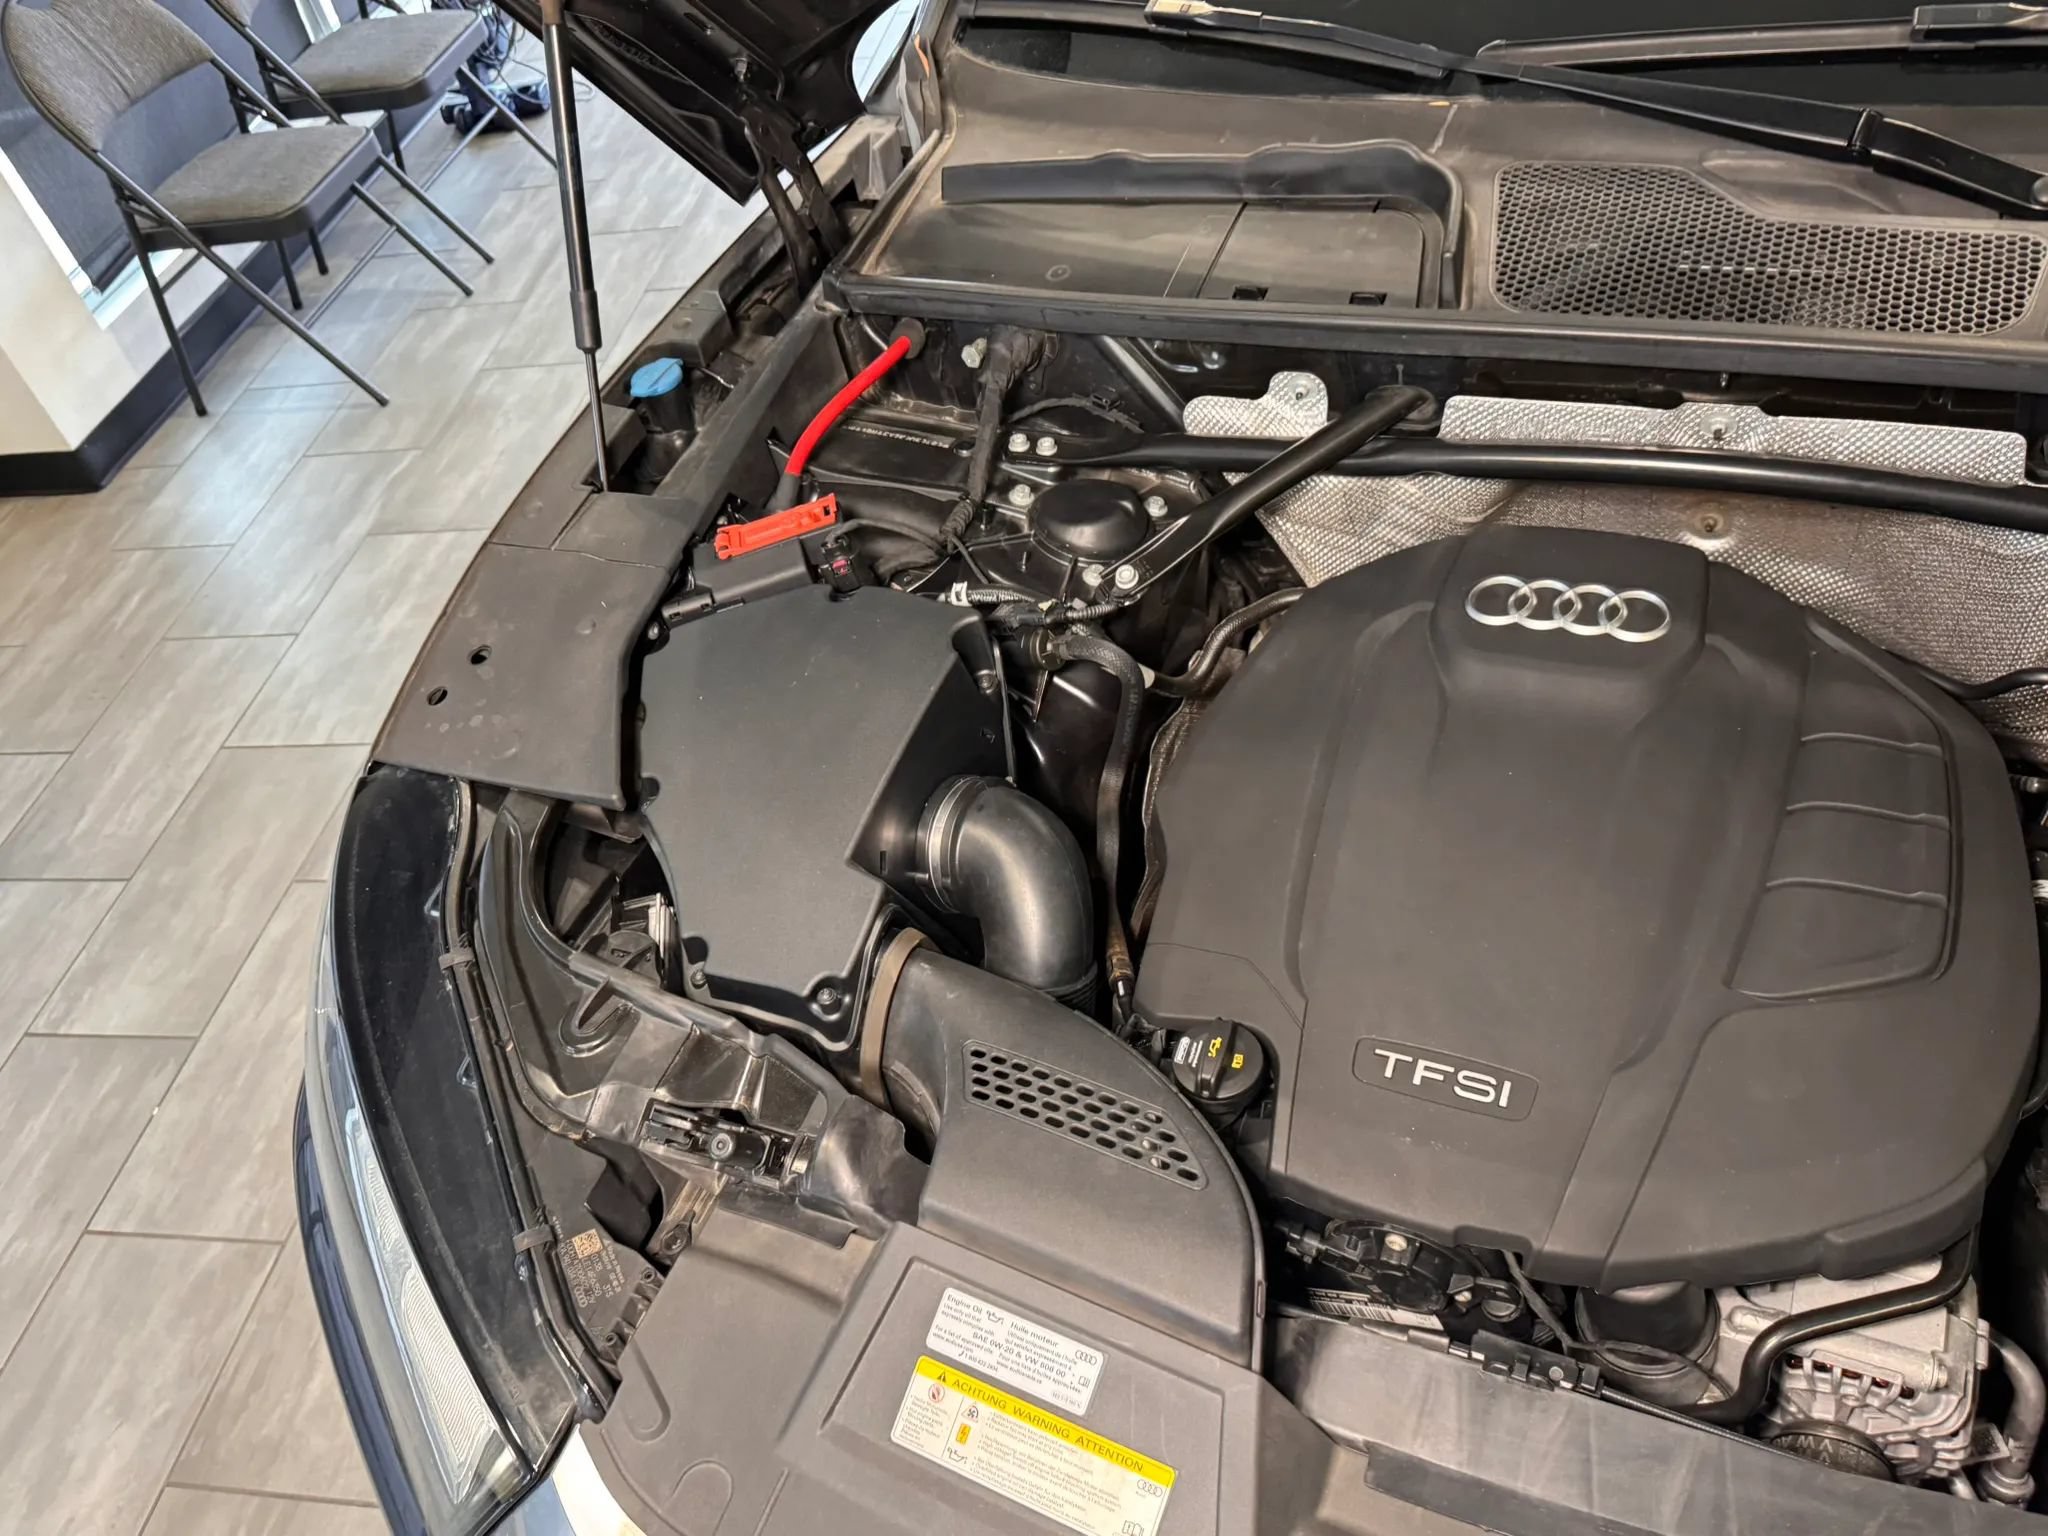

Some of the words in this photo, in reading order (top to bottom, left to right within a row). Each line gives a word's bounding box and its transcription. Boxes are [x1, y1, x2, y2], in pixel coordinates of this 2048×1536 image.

[1374, 1048, 1512, 1108] TFSI
[947, 1294, 970, 1309] Engine
[972, 1305, 982, 1314] Oil
[973, 1332, 988, 1343] SAE
[1025, 1355, 1038, 1365] VW
[1010, 1322, 1028, 1334] Huile
[1030, 1332, 1058, 1347] moteur
[952, 1379, 1006, 1410] ACHTUNG
[1013, 1406, 1069, 1439] WARNING
[1076, 1436, 1144, 1472] ATTENTION
